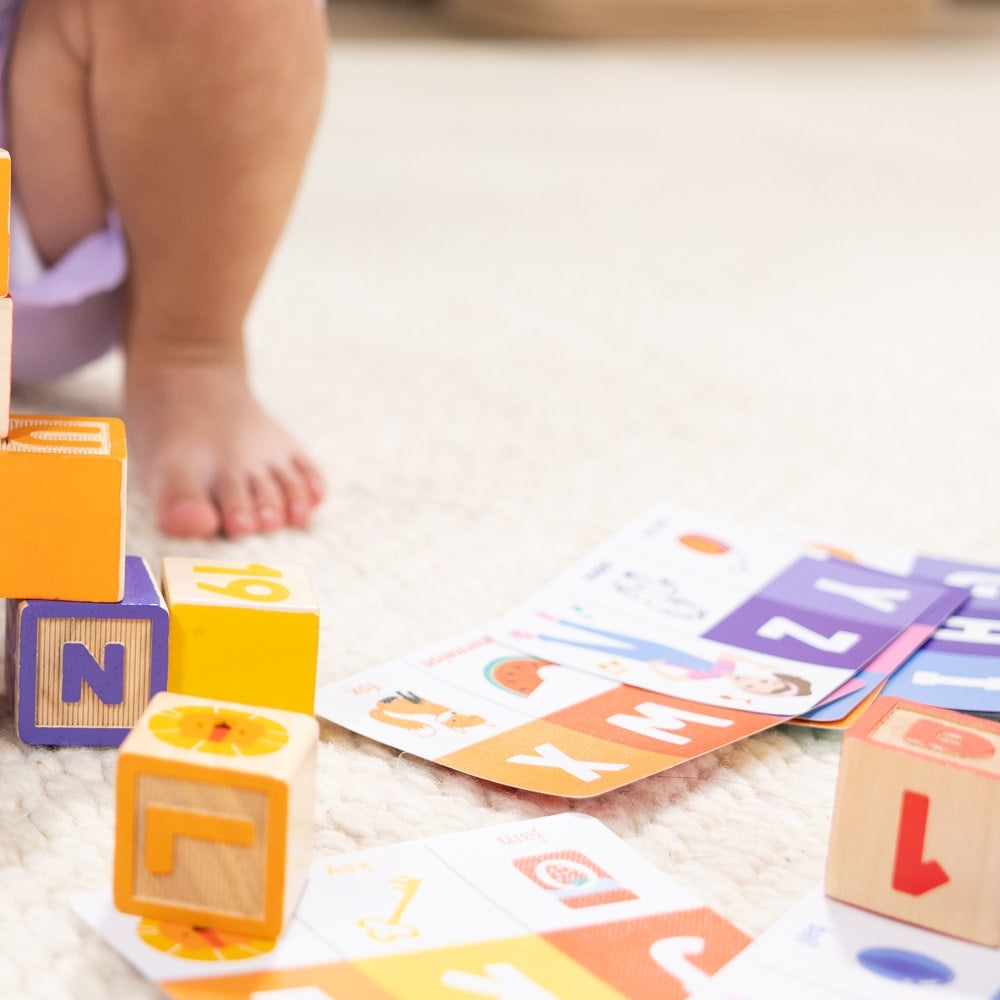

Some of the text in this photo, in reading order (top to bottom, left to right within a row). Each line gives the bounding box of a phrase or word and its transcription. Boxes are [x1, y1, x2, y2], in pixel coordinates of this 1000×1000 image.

[505, 743, 630, 783] X
[146, 806, 255, 876] L
[892, 789, 950, 896] 1
